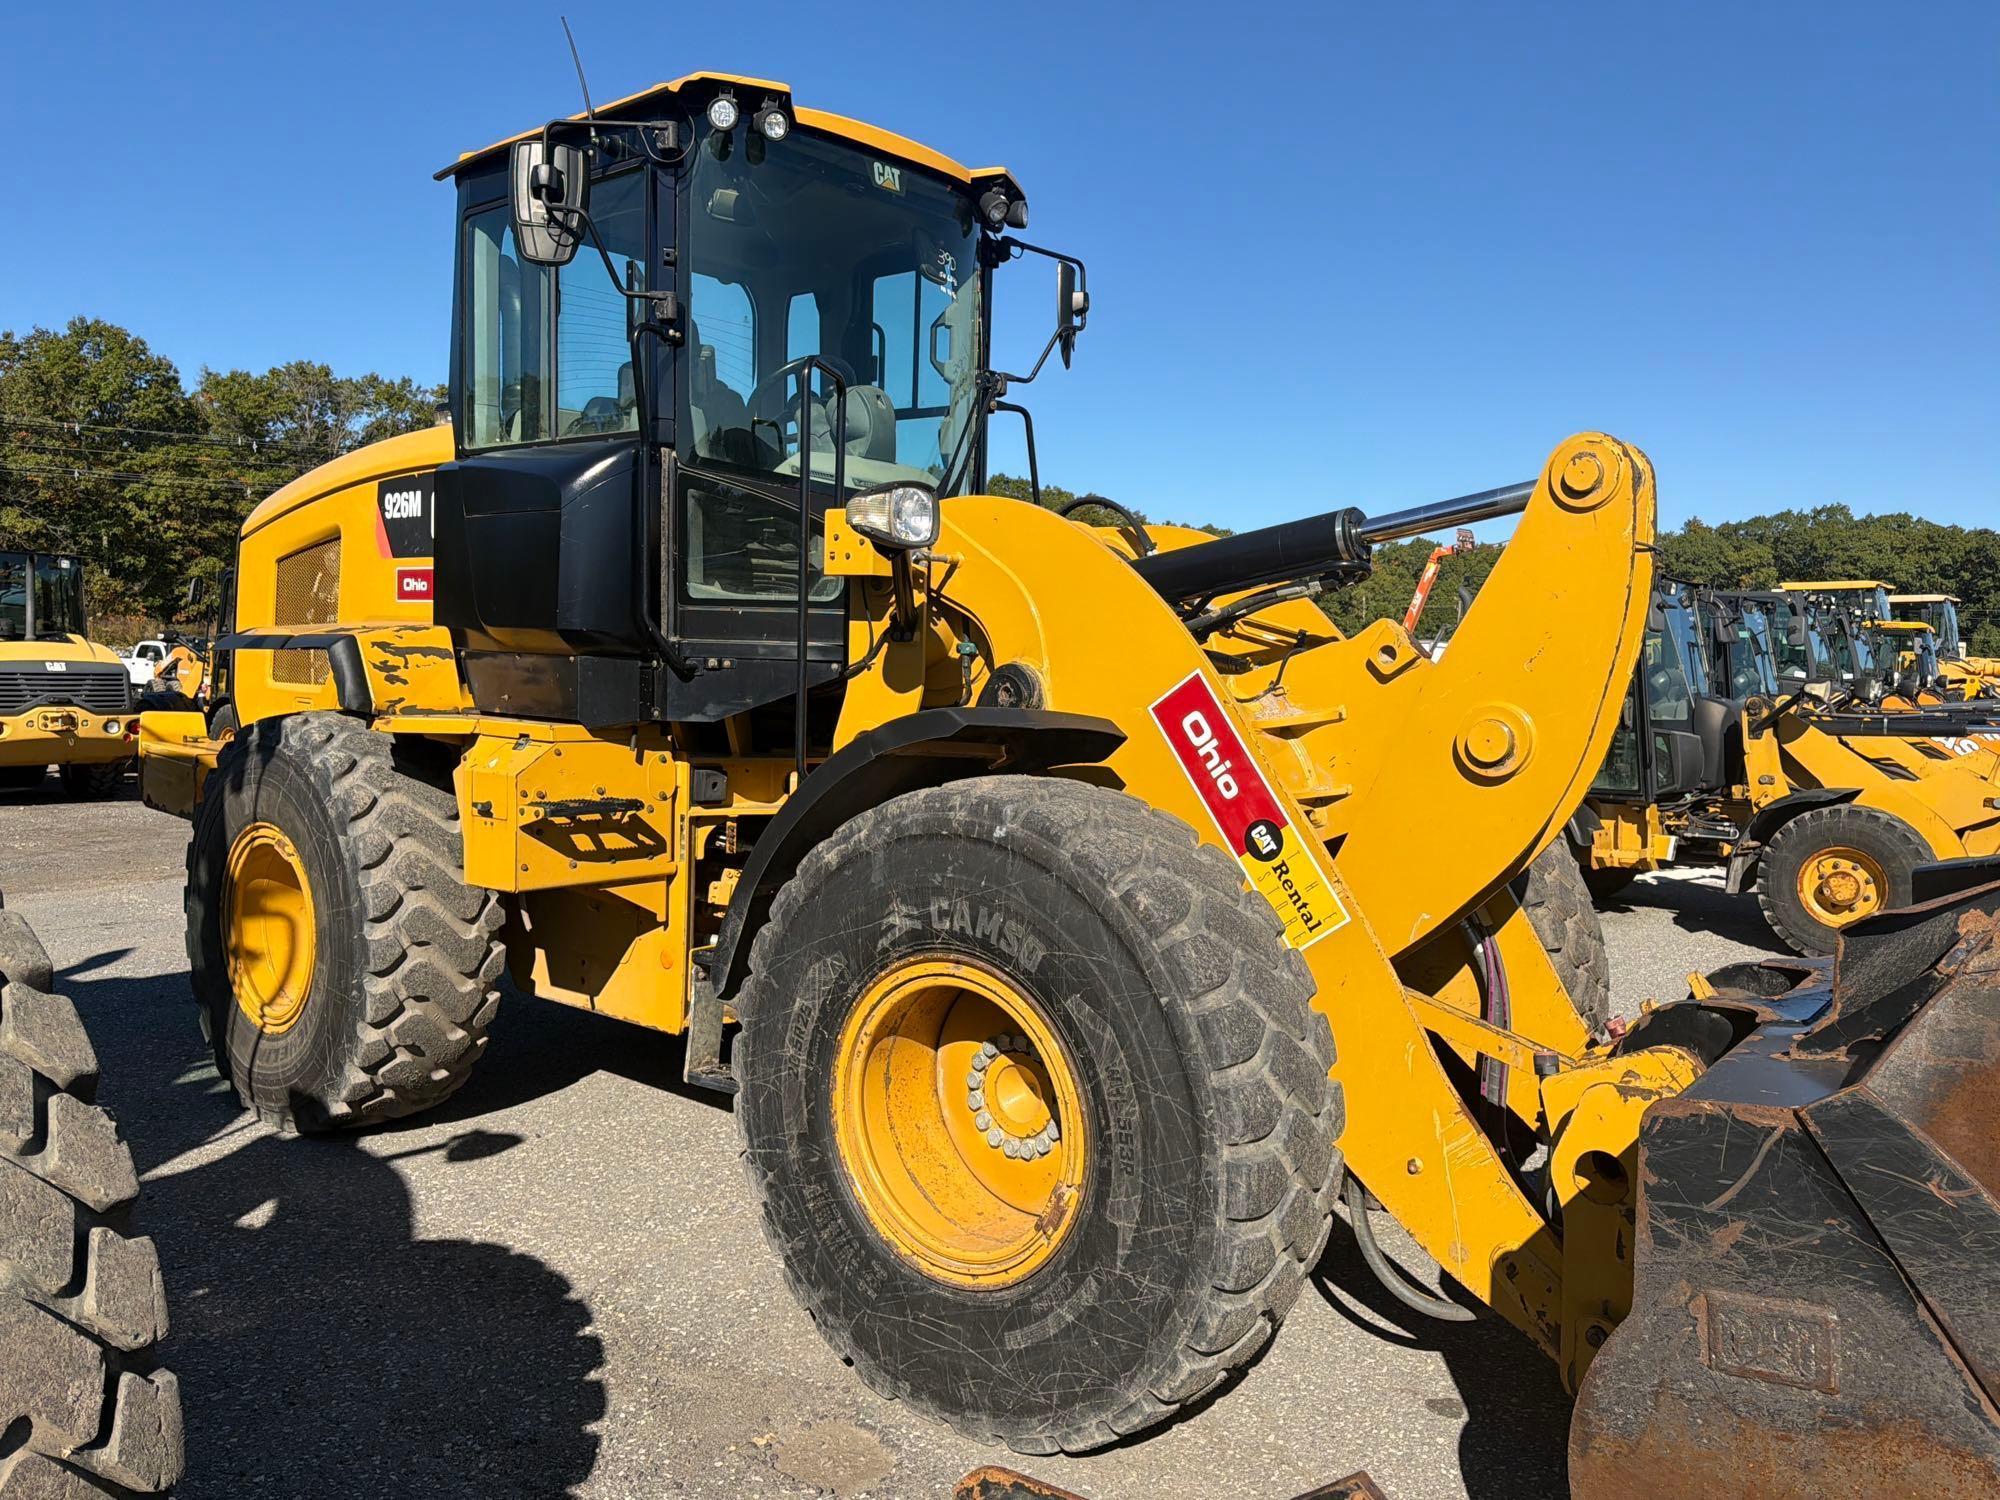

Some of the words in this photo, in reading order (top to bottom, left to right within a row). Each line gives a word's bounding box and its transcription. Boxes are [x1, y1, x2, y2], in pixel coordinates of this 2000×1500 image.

[873, 161, 901, 192] CAT
[384, 490, 422, 519] 926M
[403, 577, 428, 592] Ohio
[45, 661, 67, 671] CAT
[1182, 710, 1239, 800] Ohio
[1251, 825, 1278, 855] CAT
[1271, 859, 1323, 934] Rental
[930, 896, 1047, 974] CAMSO
